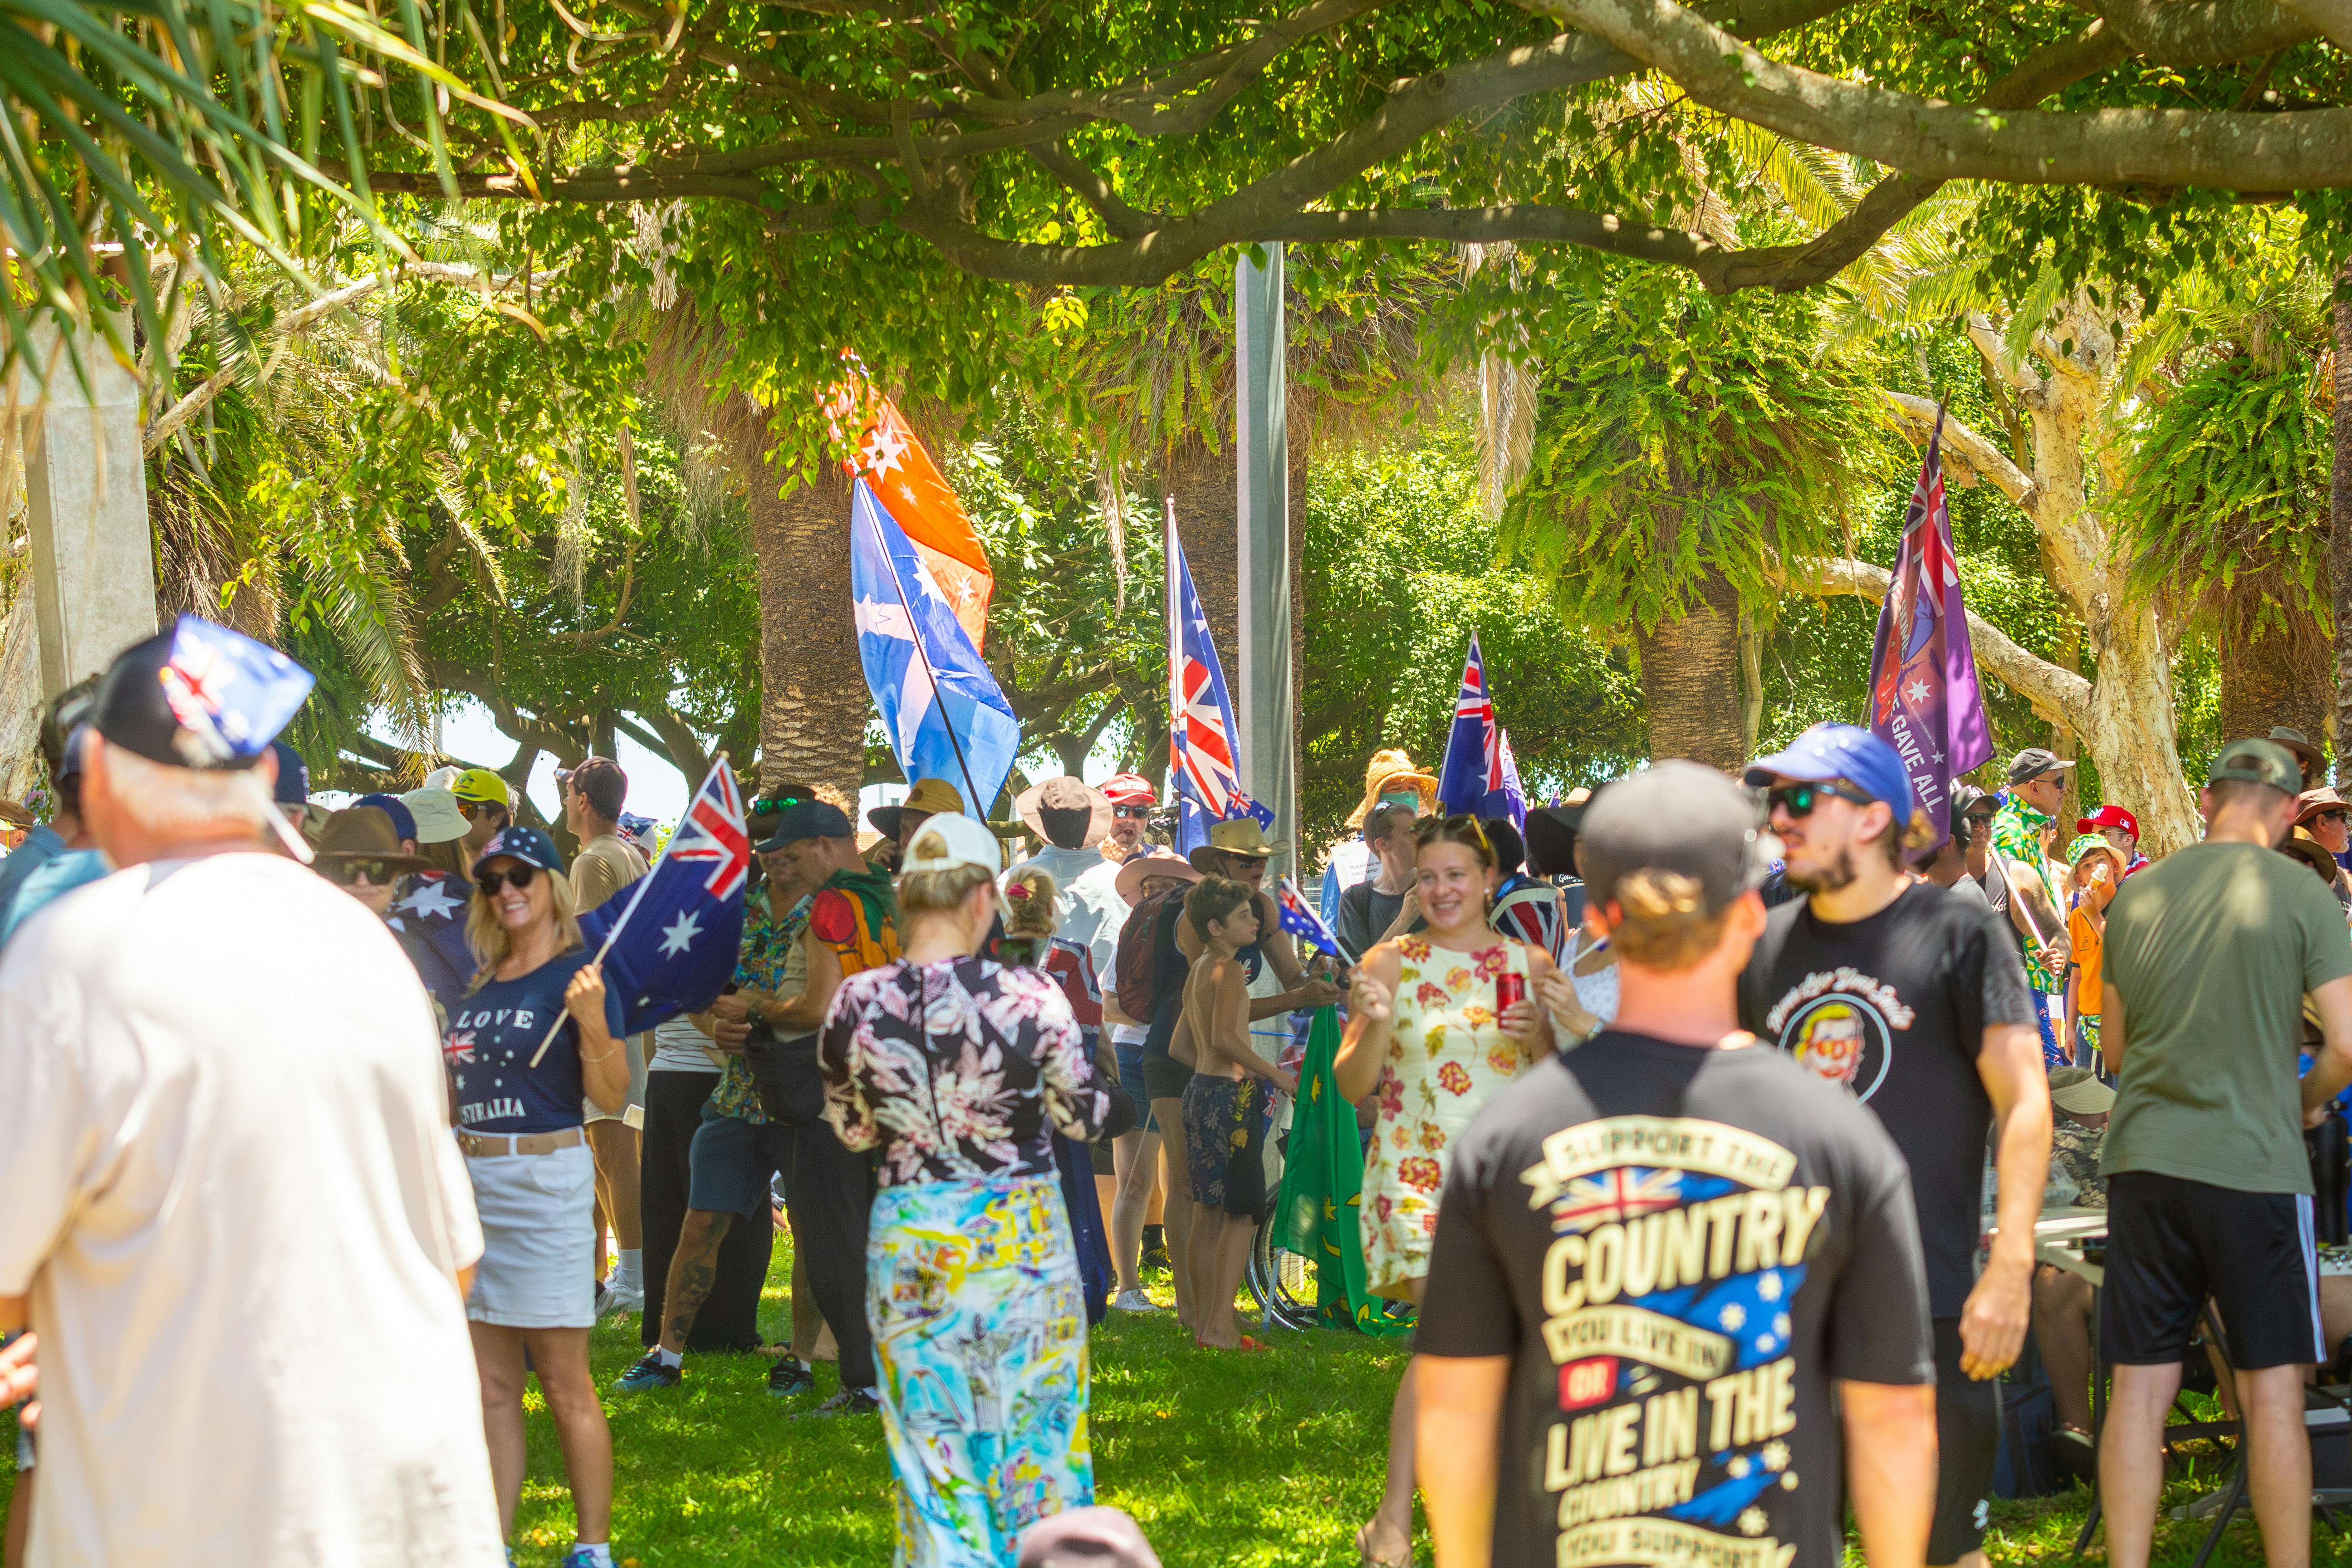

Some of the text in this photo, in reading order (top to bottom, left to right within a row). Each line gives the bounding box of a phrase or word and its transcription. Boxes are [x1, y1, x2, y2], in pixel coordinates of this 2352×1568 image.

[1891, 715, 1925, 773] GAVE
[1912, 774, 1944, 814] ALL
[1965, 784, 1981, 798] LA
[456, 1009, 534, 1029] LOVE
[1562, 1129, 1781, 1179] SUPPORT THE
[1542, 1185, 1832, 1317] COUNTRY
[1559, 1316, 1720, 1369] YOU LIVE IN
[1567, 1361, 1609, 1403] OR
[1544, 1355, 1797, 1492] LIVE IN THE
[1557, 1455, 1701, 1531] COUNTRY
[1568, 1530, 1617, 1556] YOU
